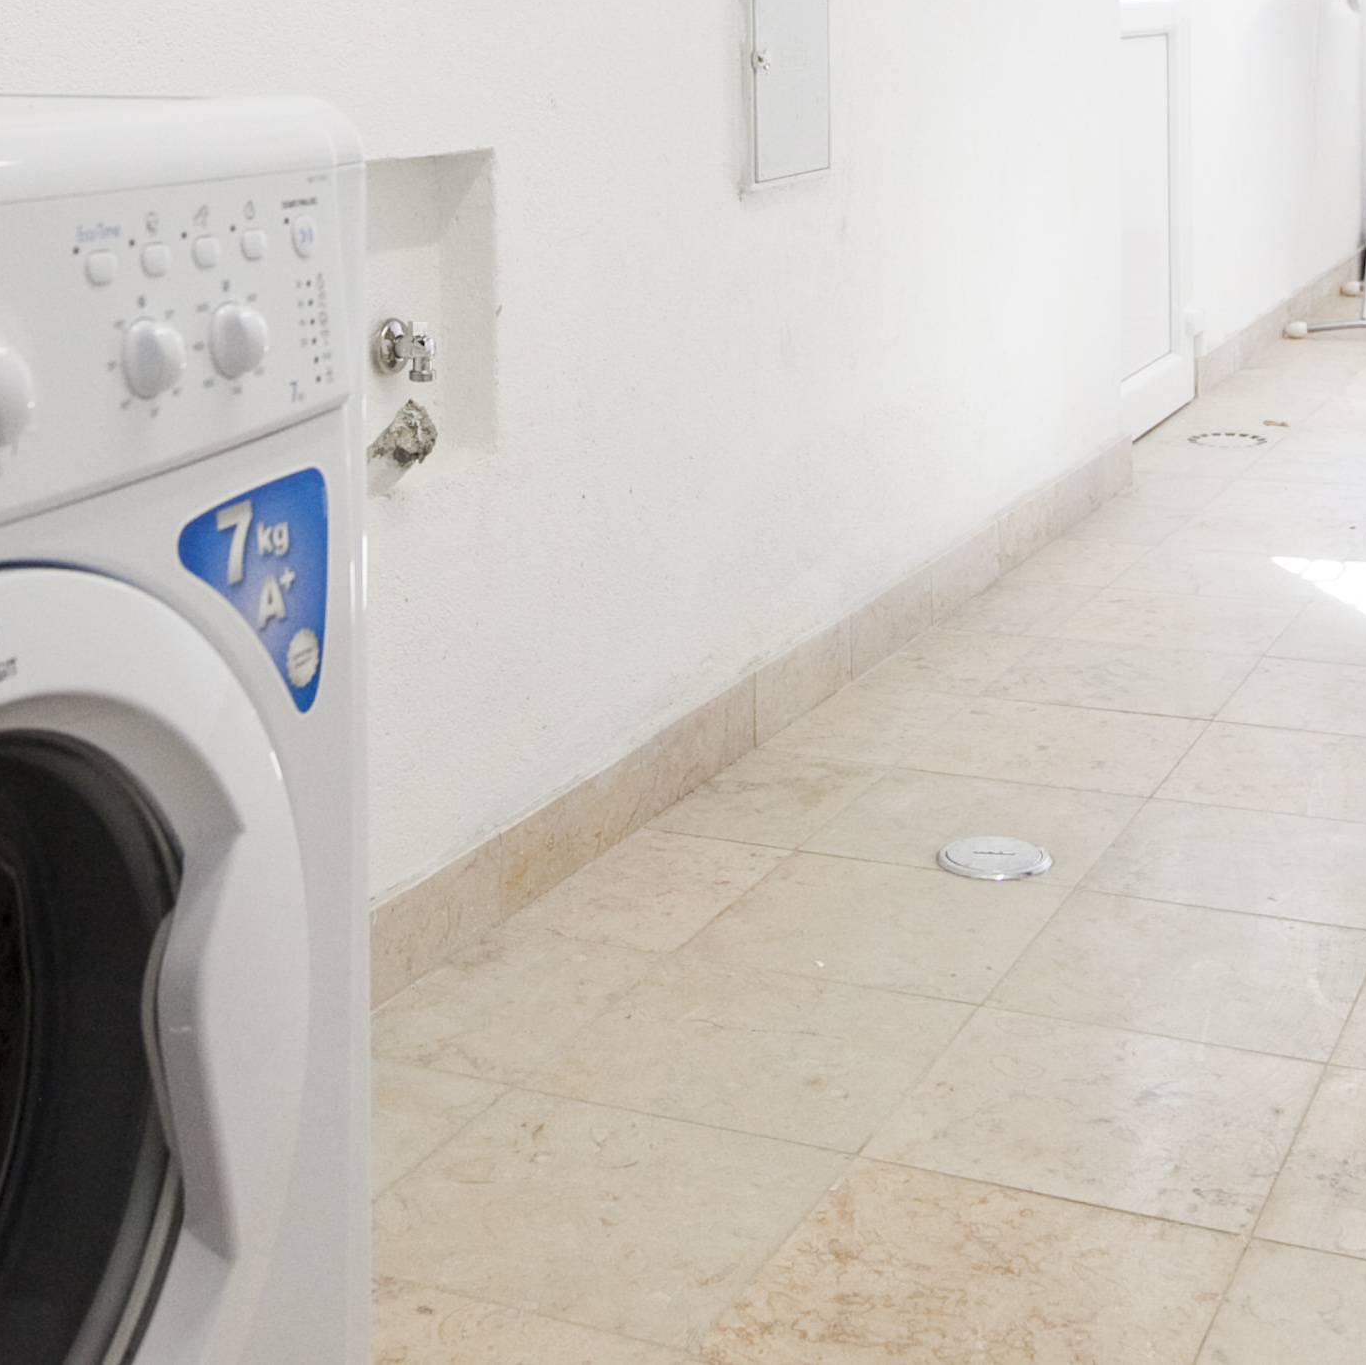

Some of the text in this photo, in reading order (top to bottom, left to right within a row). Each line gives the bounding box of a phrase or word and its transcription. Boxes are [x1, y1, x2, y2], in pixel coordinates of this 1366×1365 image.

[216, 499, 290, 585] 7 kg
[258, 566, 296, 632] A+
